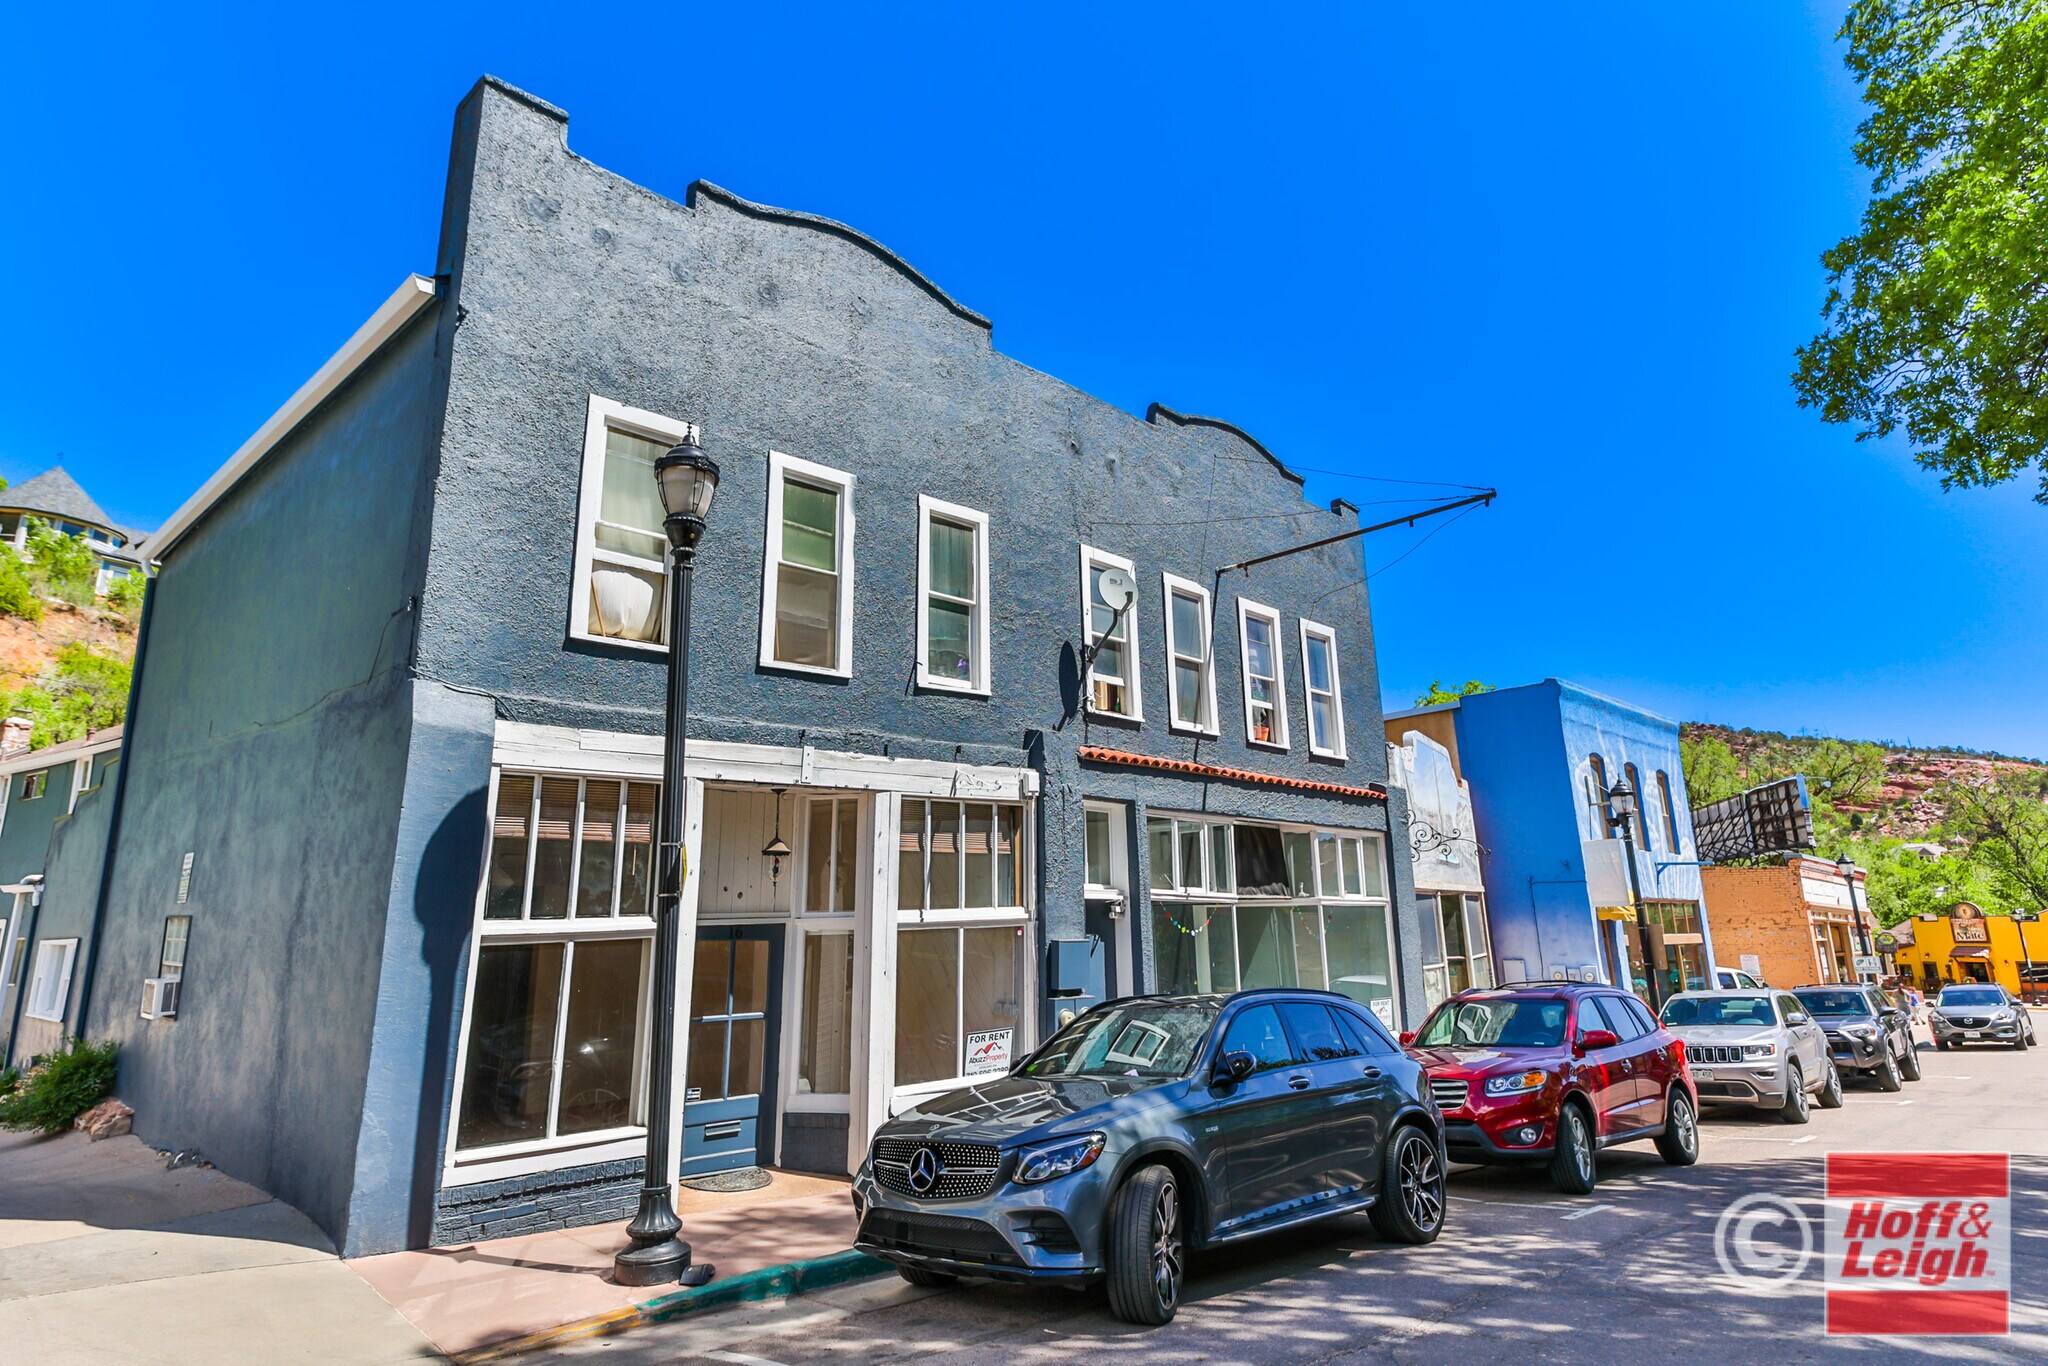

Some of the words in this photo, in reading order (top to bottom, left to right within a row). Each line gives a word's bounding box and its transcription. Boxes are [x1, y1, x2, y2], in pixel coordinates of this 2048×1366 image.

[729, 926, 743, 939] 16
[969, 1034, 987, 1044] FOR
[988, 1031, 1010, 1041] RENT
